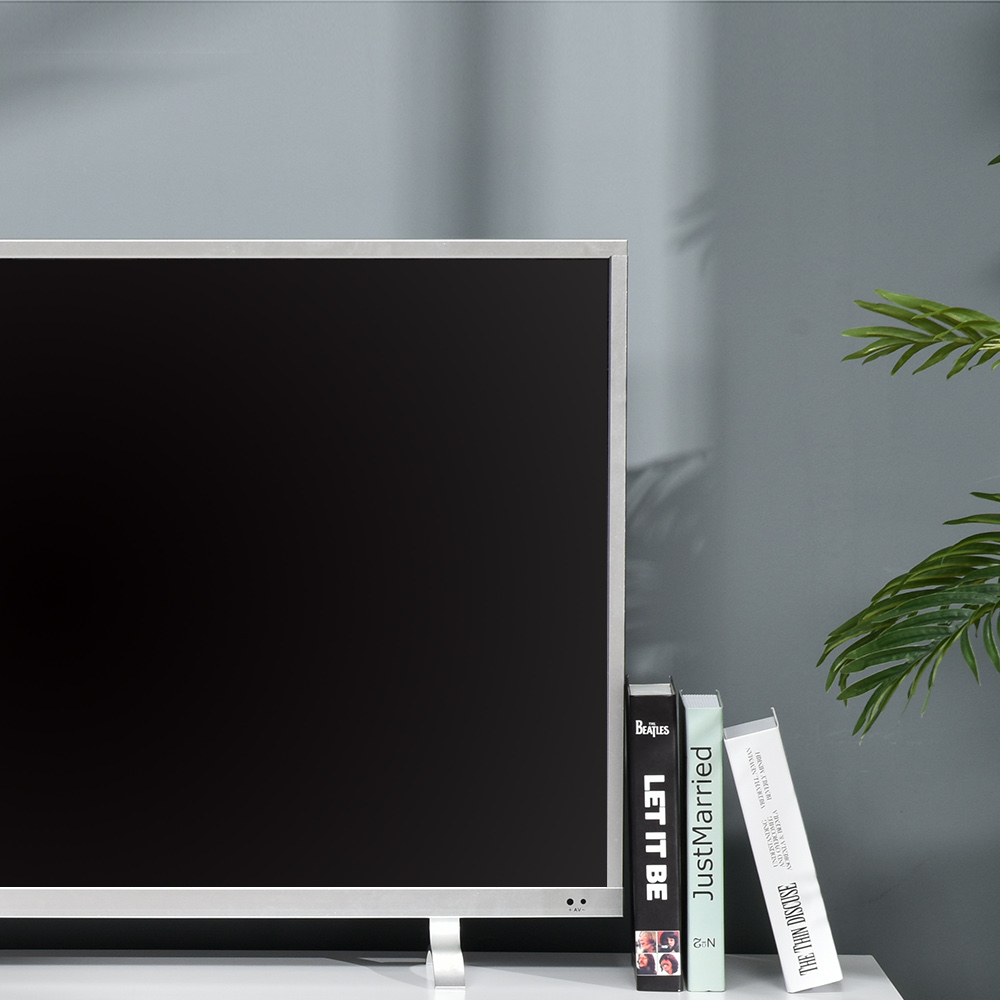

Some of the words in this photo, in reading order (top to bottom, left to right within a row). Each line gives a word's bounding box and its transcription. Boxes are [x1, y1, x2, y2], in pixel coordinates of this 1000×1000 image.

[635, 719, 670, 738] BEATLES
[643, 774, 666, 825] LET
[690, 746, 713, 901] JustMarried
[645, 832, 667, 858] IT
[645, 864, 668, 901] BE
[791, 926, 812, 953] THIN
[797, 952, 818, 976] THE
